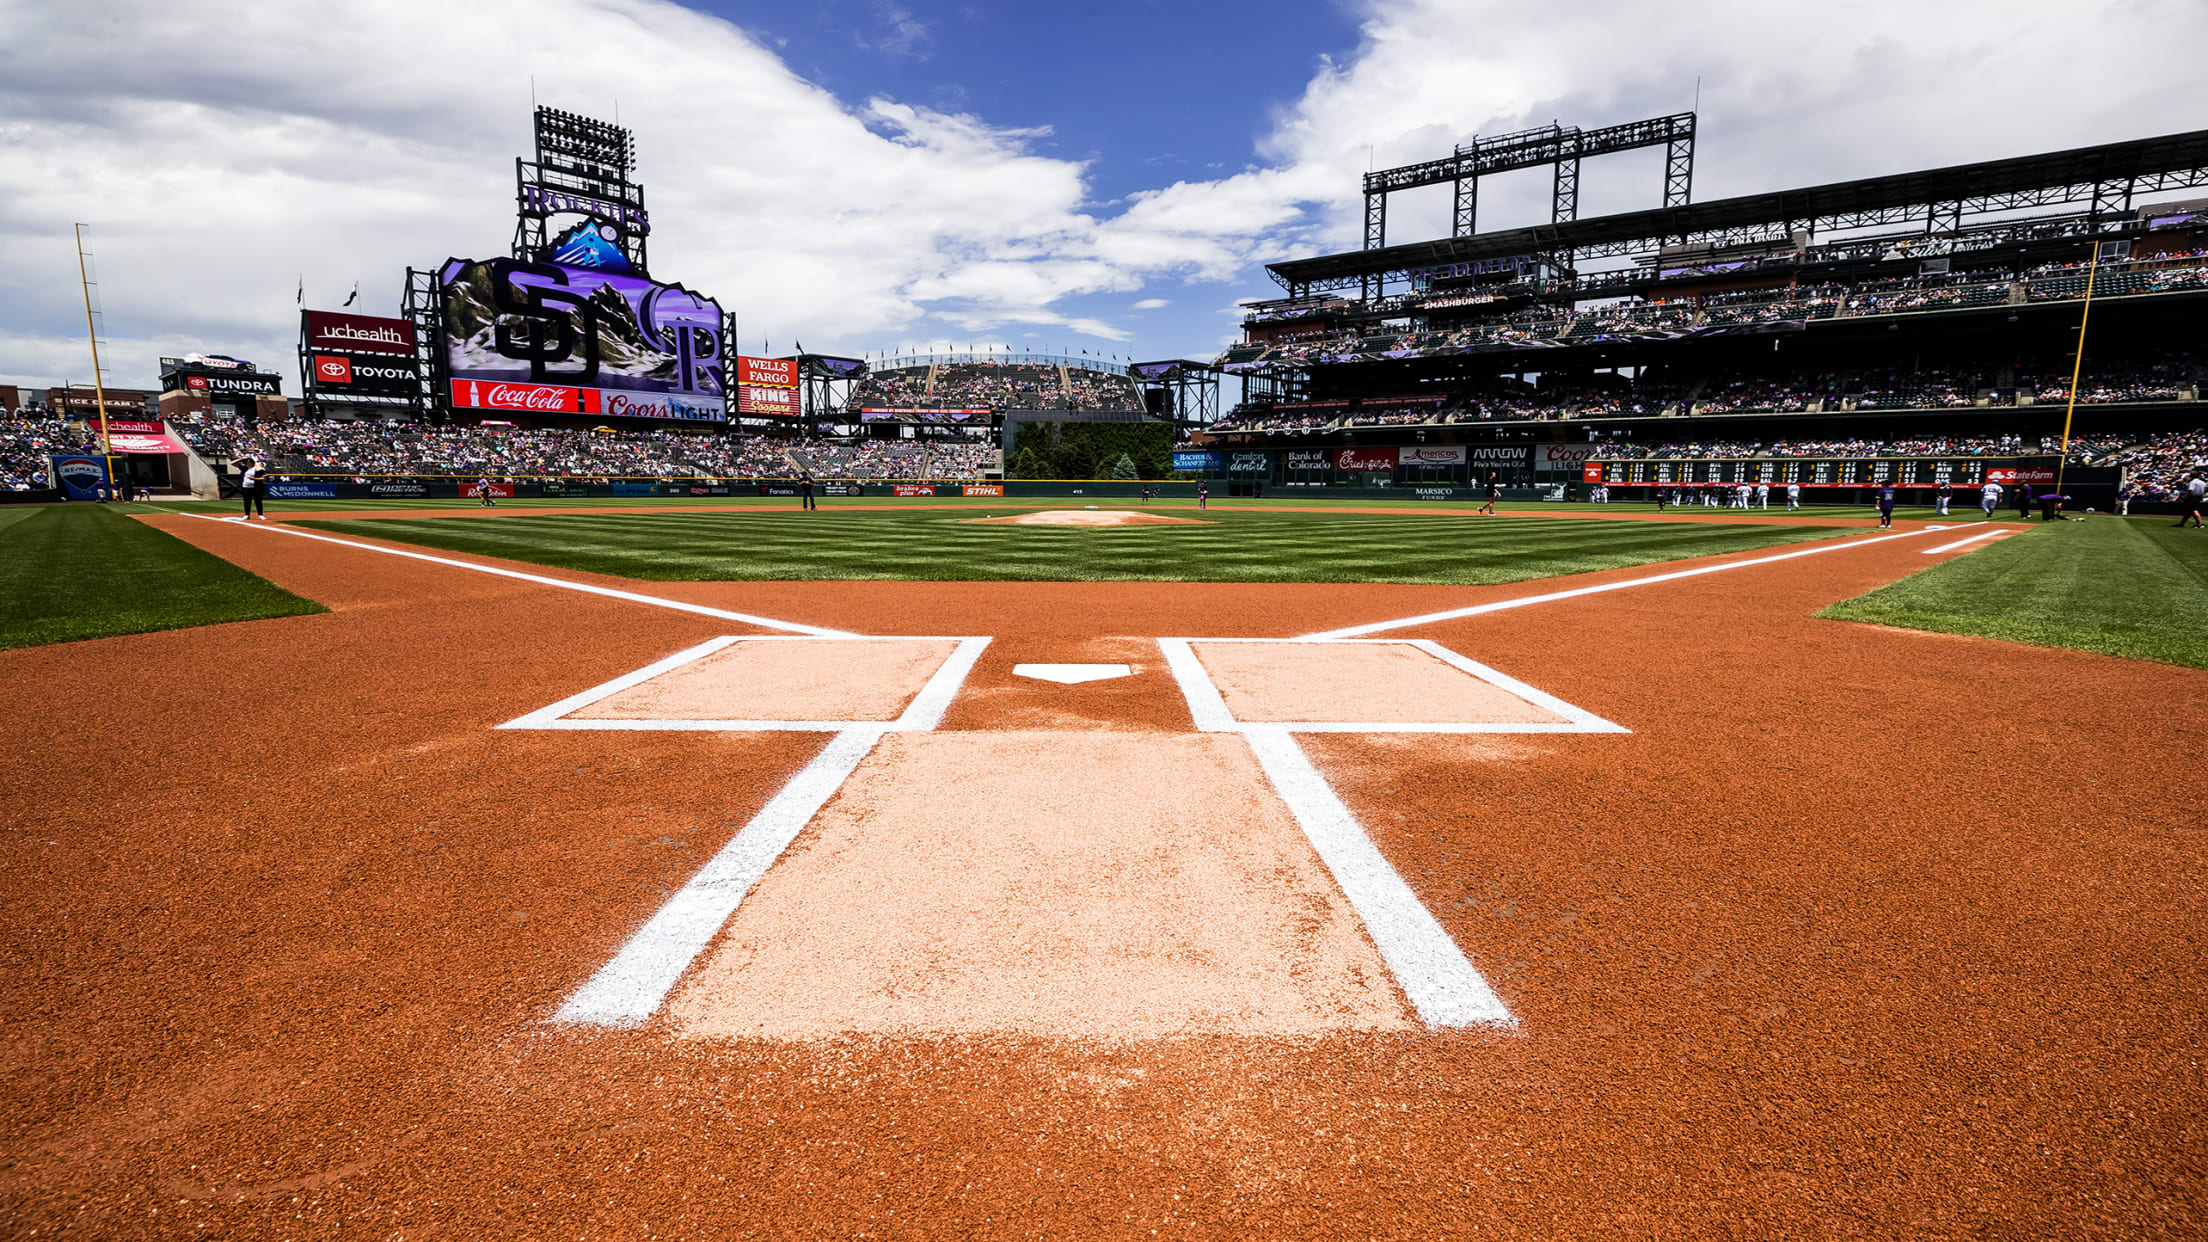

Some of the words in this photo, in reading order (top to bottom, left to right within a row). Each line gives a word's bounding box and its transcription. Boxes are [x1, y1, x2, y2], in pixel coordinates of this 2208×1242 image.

[526, 187, 651, 234] ROCKIES
[1424, 295, 1494, 309] SMASHBURGER
[323, 323, 402, 344] uchealth
[747, 359, 789, 372] WELLS
[351, 366, 417, 380] TOYOTA
[749, 371, 789, 384] FARGO
[206, 378, 275, 391] TUNDRA
[488, 384, 567, 410] Coca-Cola
[749, 388, 790, 403] KING
[92, 399, 131, 407] CEAM
[607, 394, 669, 418] Coors
[671, 404, 720, 420] LIGHT
[750, 400, 791, 414] Soopers
[1232, 451, 1264, 461] Comfort
[1288, 450, 1312, 461] Bank
[1312, 450, 1324, 461] of
[1473, 447, 1527, 459] ARROW
[1230, 459, 1267, 471] dental
[1288, 460, 1331, 470] Colorado
[1556, 461, 1584, 470] LIGH
[966, 487, 999, 495] STIHL
